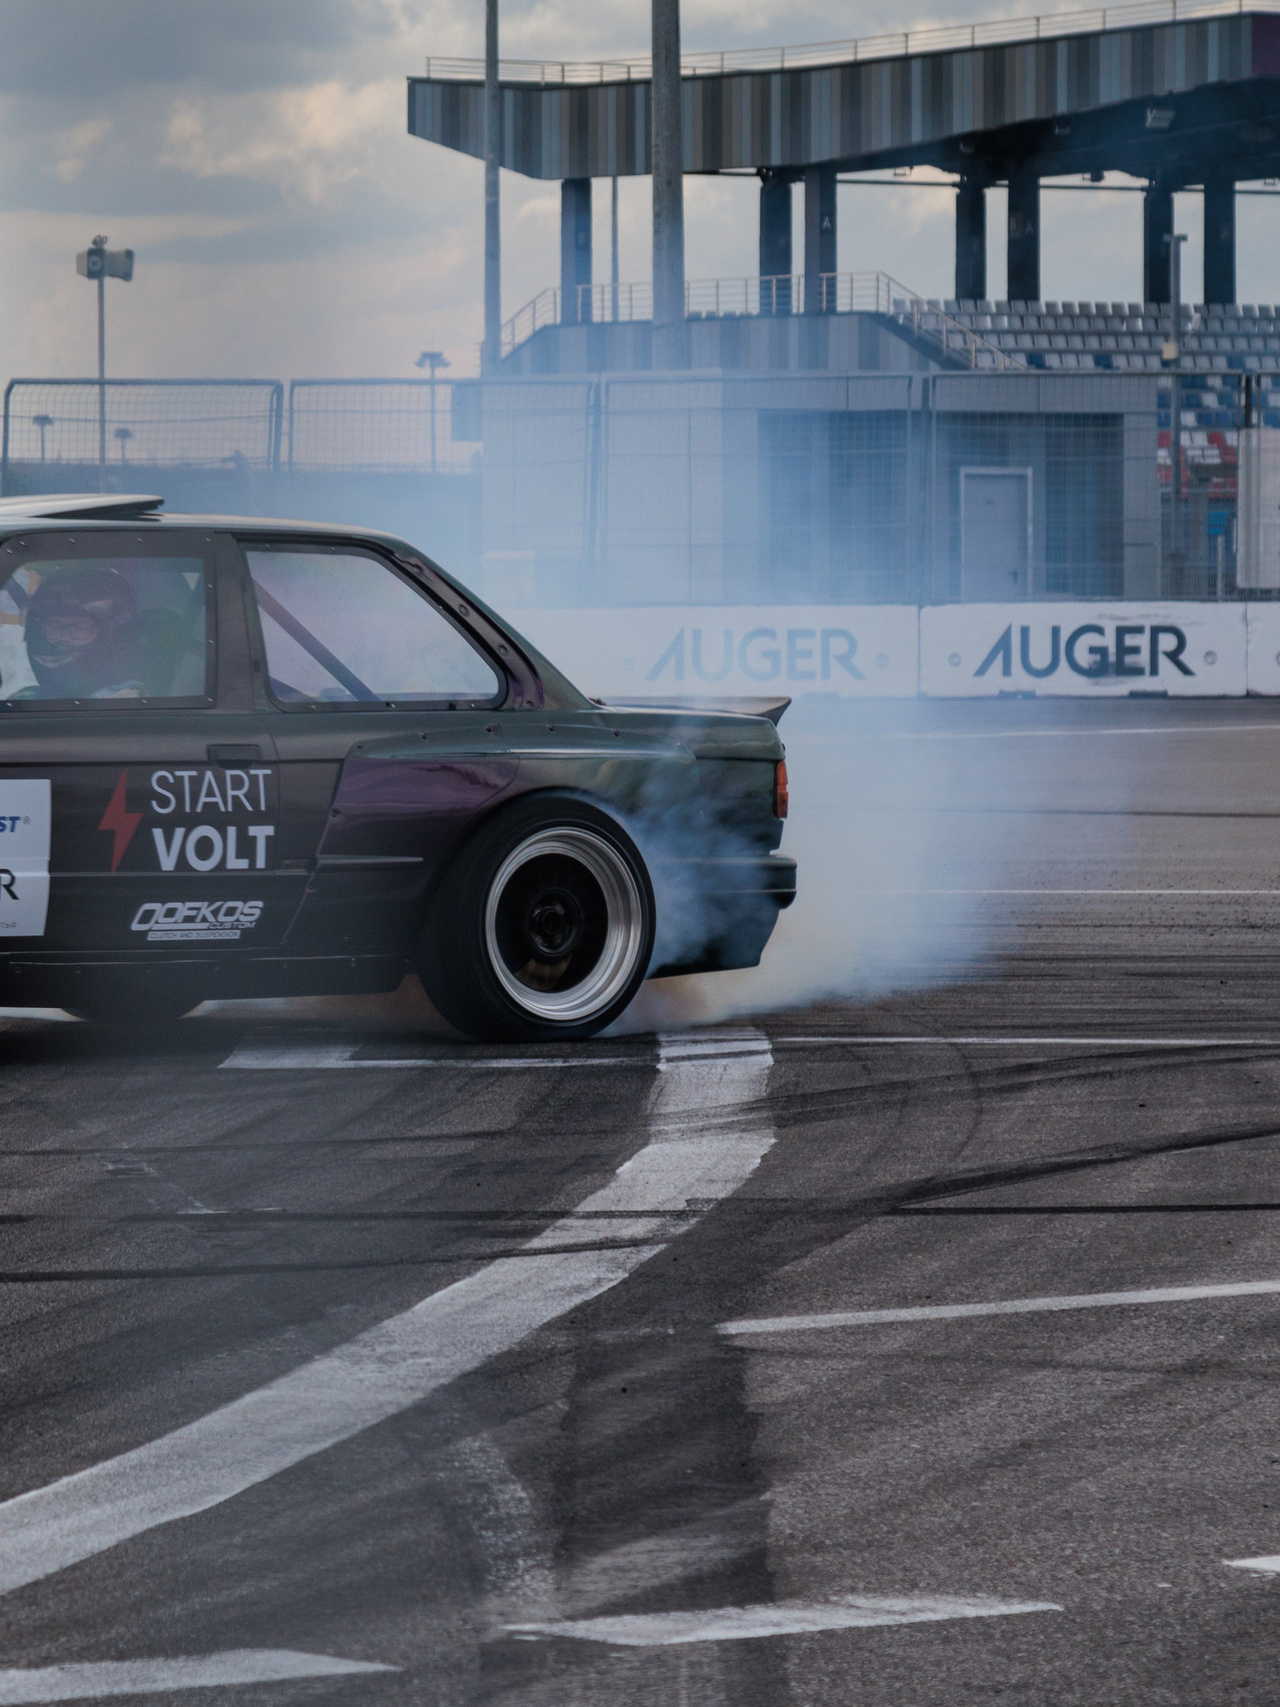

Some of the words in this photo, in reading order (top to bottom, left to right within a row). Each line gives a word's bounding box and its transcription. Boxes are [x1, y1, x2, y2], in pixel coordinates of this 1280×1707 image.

[645, 626, 867, 683] AUGER
[973, 622, 1195, 678] AUGER
[150, 769, 272, 814] START
[150, 825, 275, 872] VOLT
[149, 931, 178, 940] CLUTCH
[180, 931, 193, 939] AND
[195, 930, 239, 939] SUSPENSION
[208, 921, 257, 930] CUSTOM
